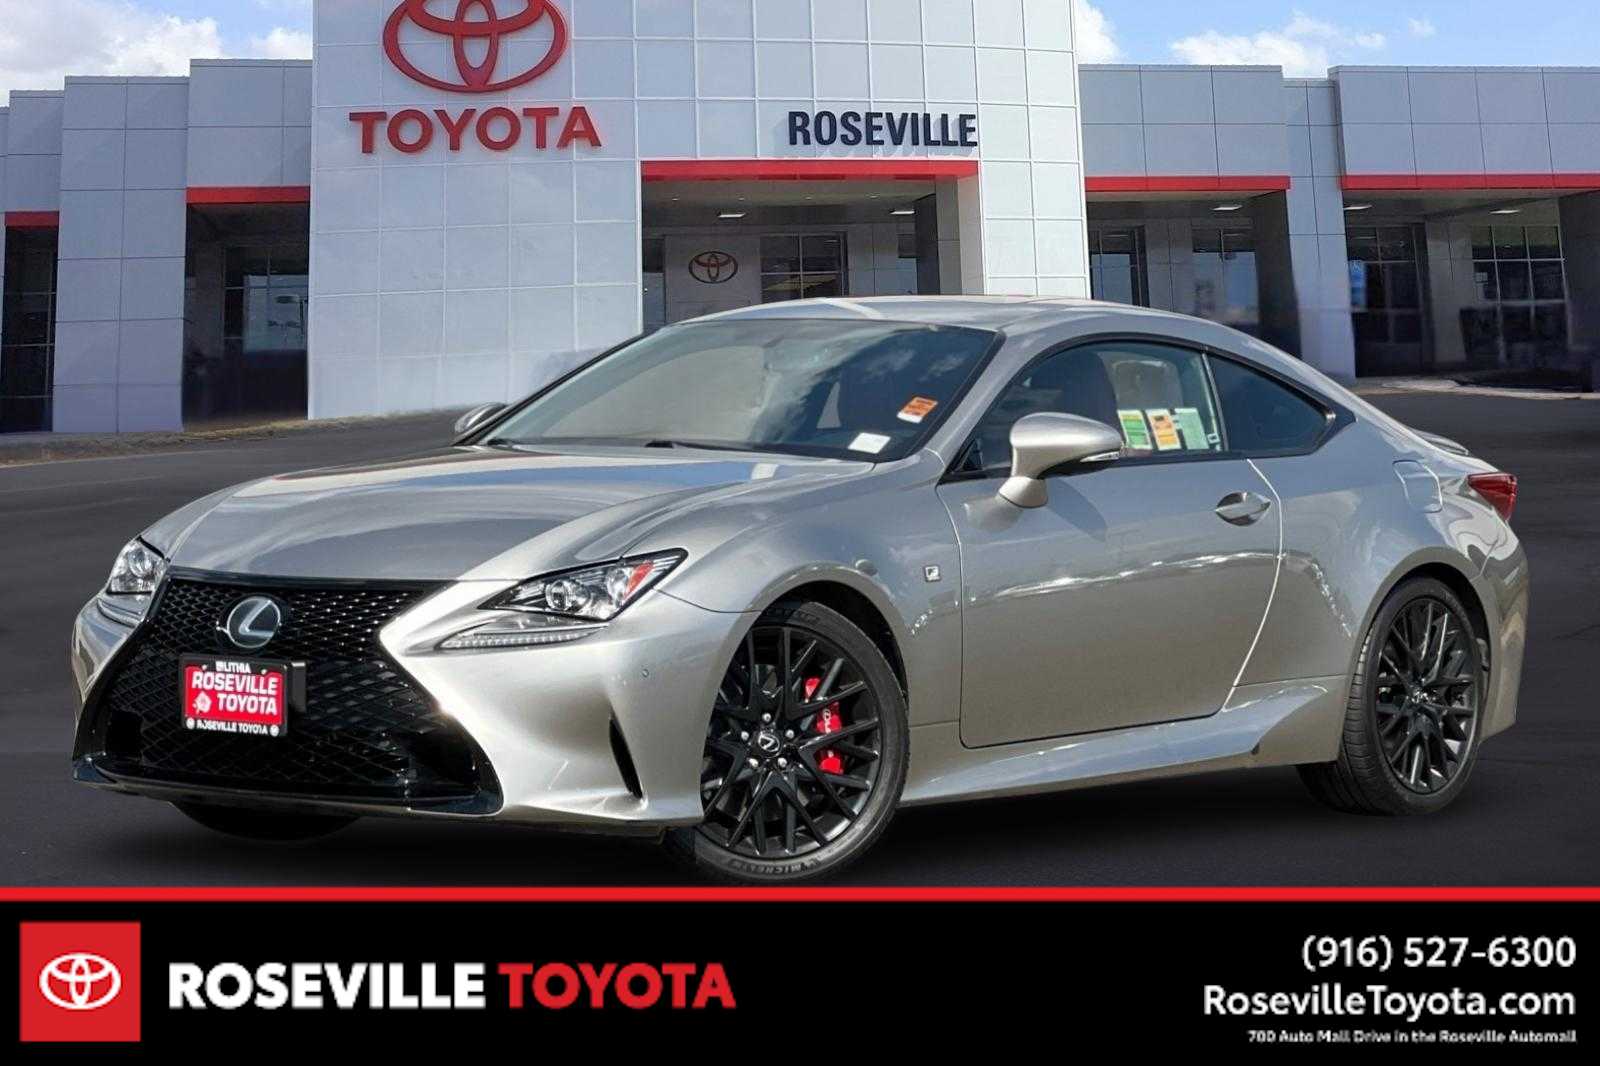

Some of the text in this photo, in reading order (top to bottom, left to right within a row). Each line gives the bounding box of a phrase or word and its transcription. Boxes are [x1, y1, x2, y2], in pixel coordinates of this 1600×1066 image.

[349, 106, 602, 154] TOYOTA
[788, 110, 978, 147] ROSEVILLE
[191, 671, 279, 696] ROSEVILLE
[217, 693, 277, 715] TOYOTA
[196, 719, 269, 735] ROSEVILLE TOYOTA
